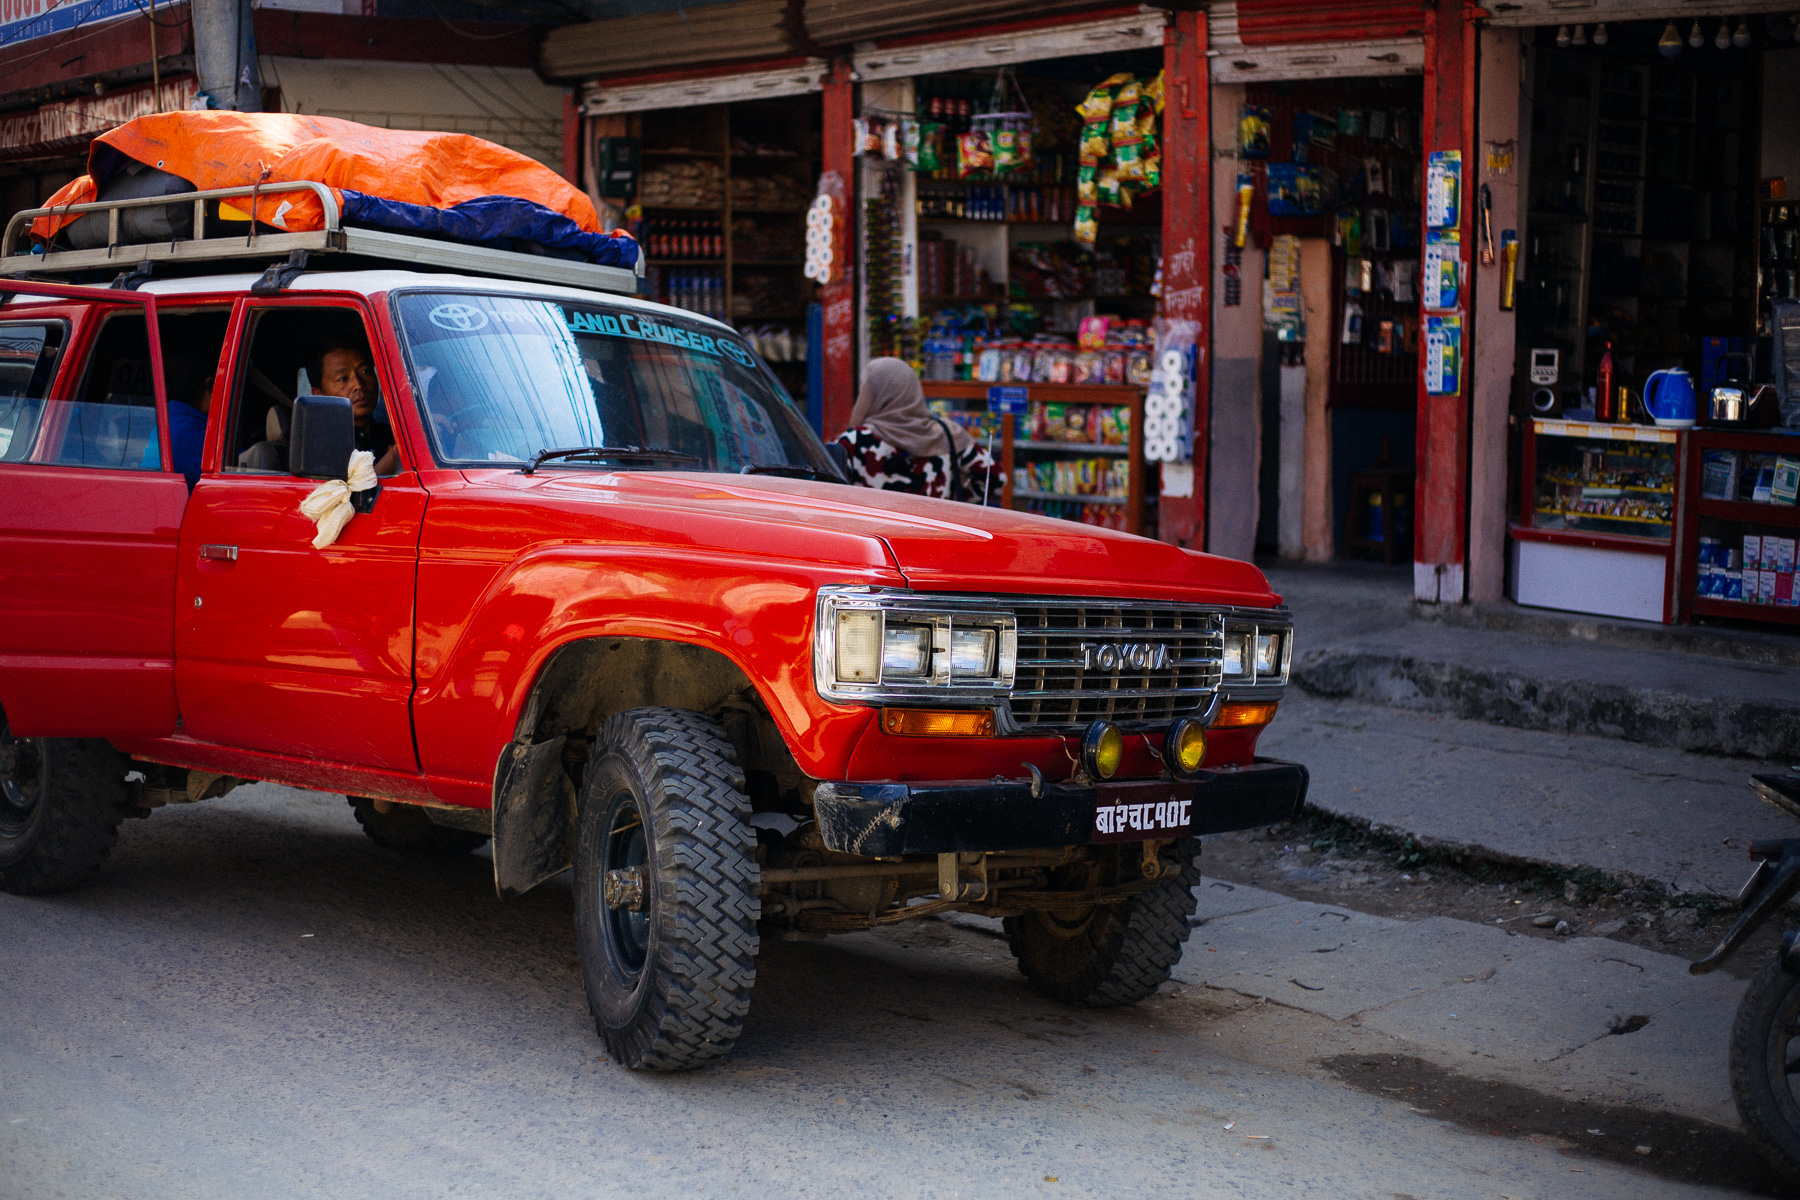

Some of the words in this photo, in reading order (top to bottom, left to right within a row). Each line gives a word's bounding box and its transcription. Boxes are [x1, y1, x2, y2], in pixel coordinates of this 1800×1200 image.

[73, 6, 86, 21] Tel
[2, 115, 40, 148] GUEST
[619, 313, 719, 354] CRUISER
[1080, 643, 1173, 671] TOYOTA
